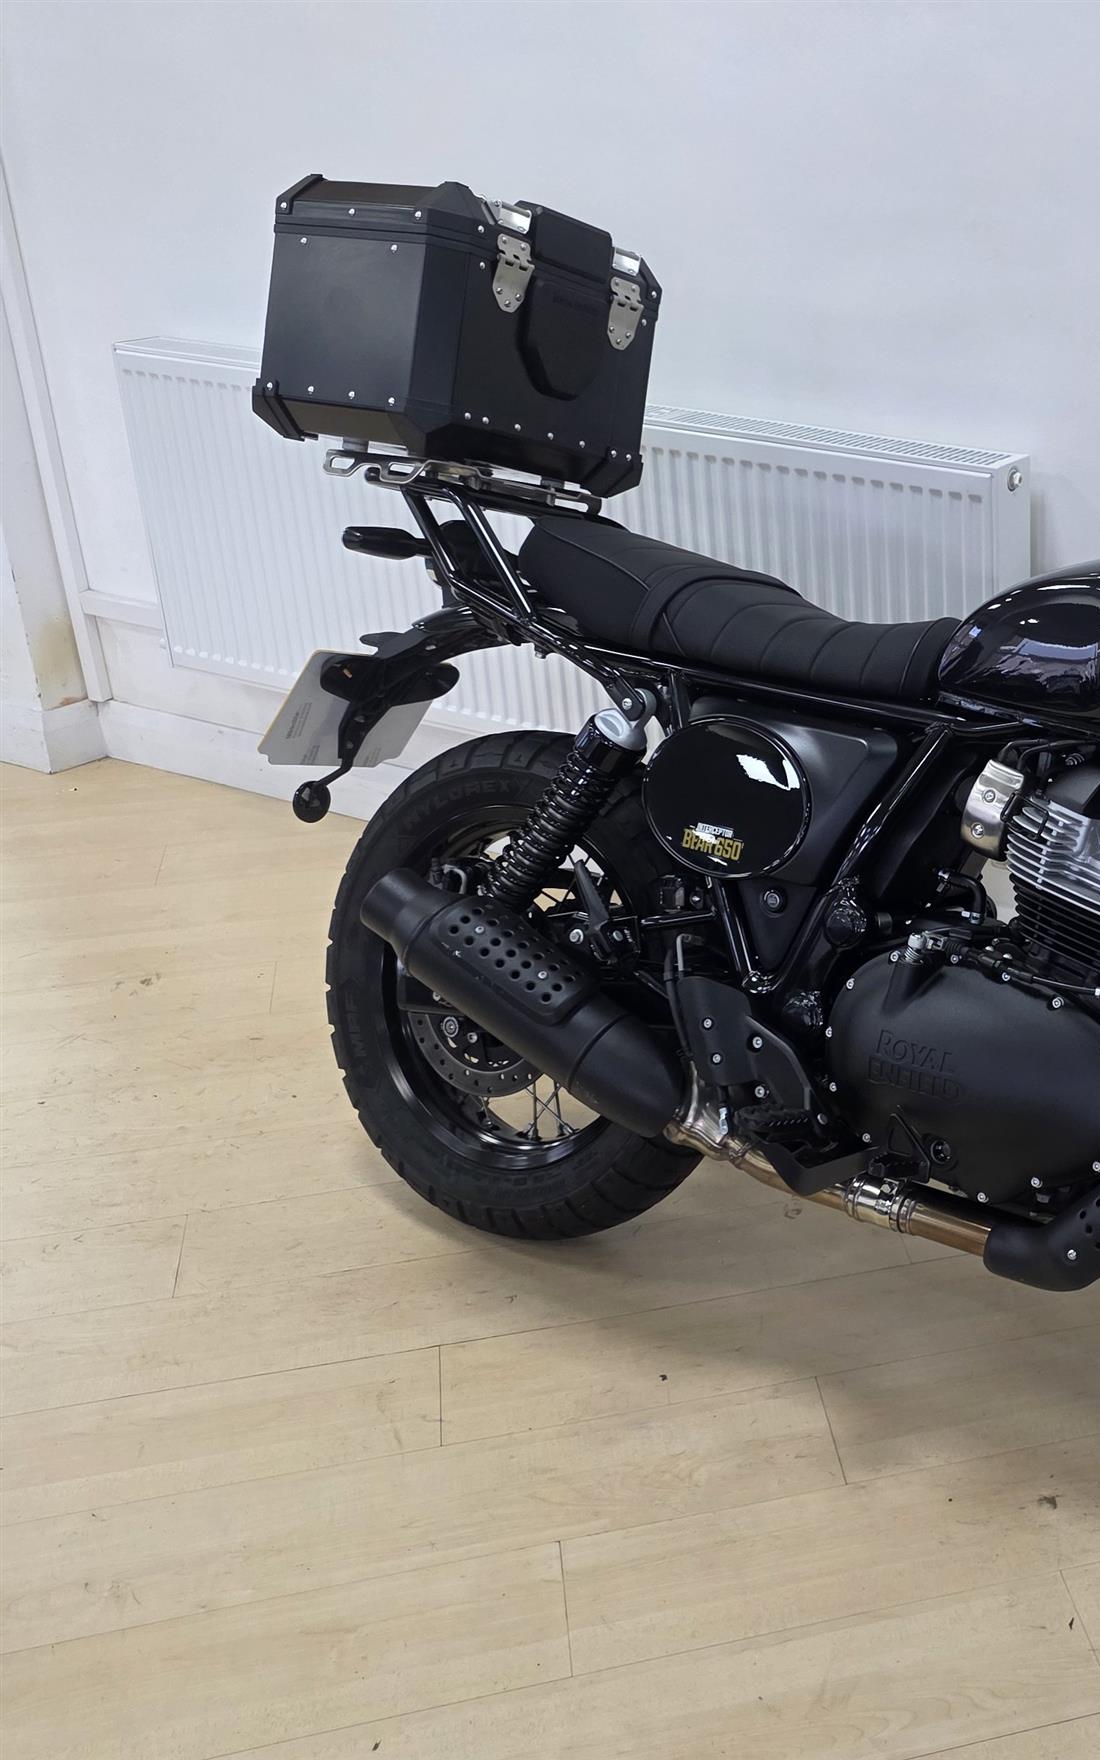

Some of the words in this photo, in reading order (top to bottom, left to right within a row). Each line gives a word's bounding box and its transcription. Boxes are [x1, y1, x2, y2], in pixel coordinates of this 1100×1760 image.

[682, 829, 715, 853] BEAR
[713, 837, 742, 861] 650
[876, 1029, 955, 1073] ROYAL
[867, 1055, 962, 1105] ENFIELD
